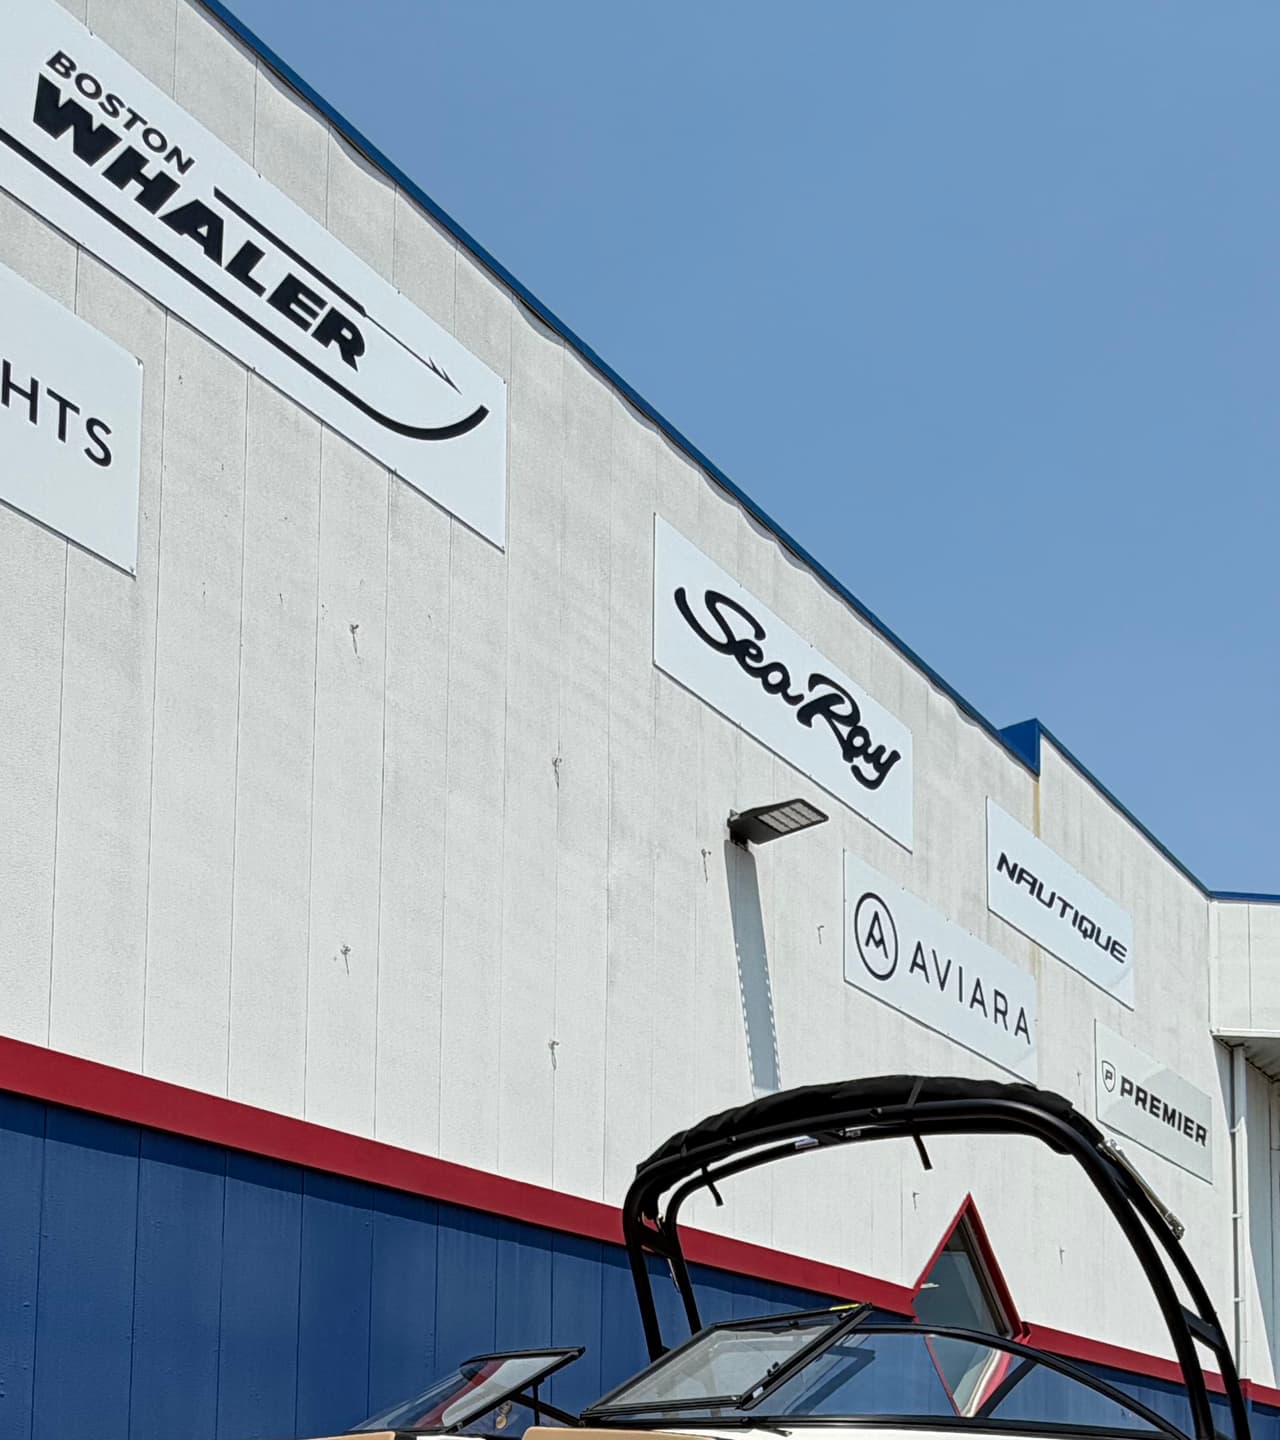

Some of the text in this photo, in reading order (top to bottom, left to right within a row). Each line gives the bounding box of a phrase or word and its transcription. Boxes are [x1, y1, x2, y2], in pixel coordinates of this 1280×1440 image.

[46, 50, 196, 176] BOSTON
[33, 72, 366, 372] WHALER
[674, 586, 902, 791] Sea Ray
[996, 852, 1128, 964] NAUTIQUE
[909, 940, 1032, 1045] AVIARA
[1119, 1075, 1208, 1147] PREMIER
